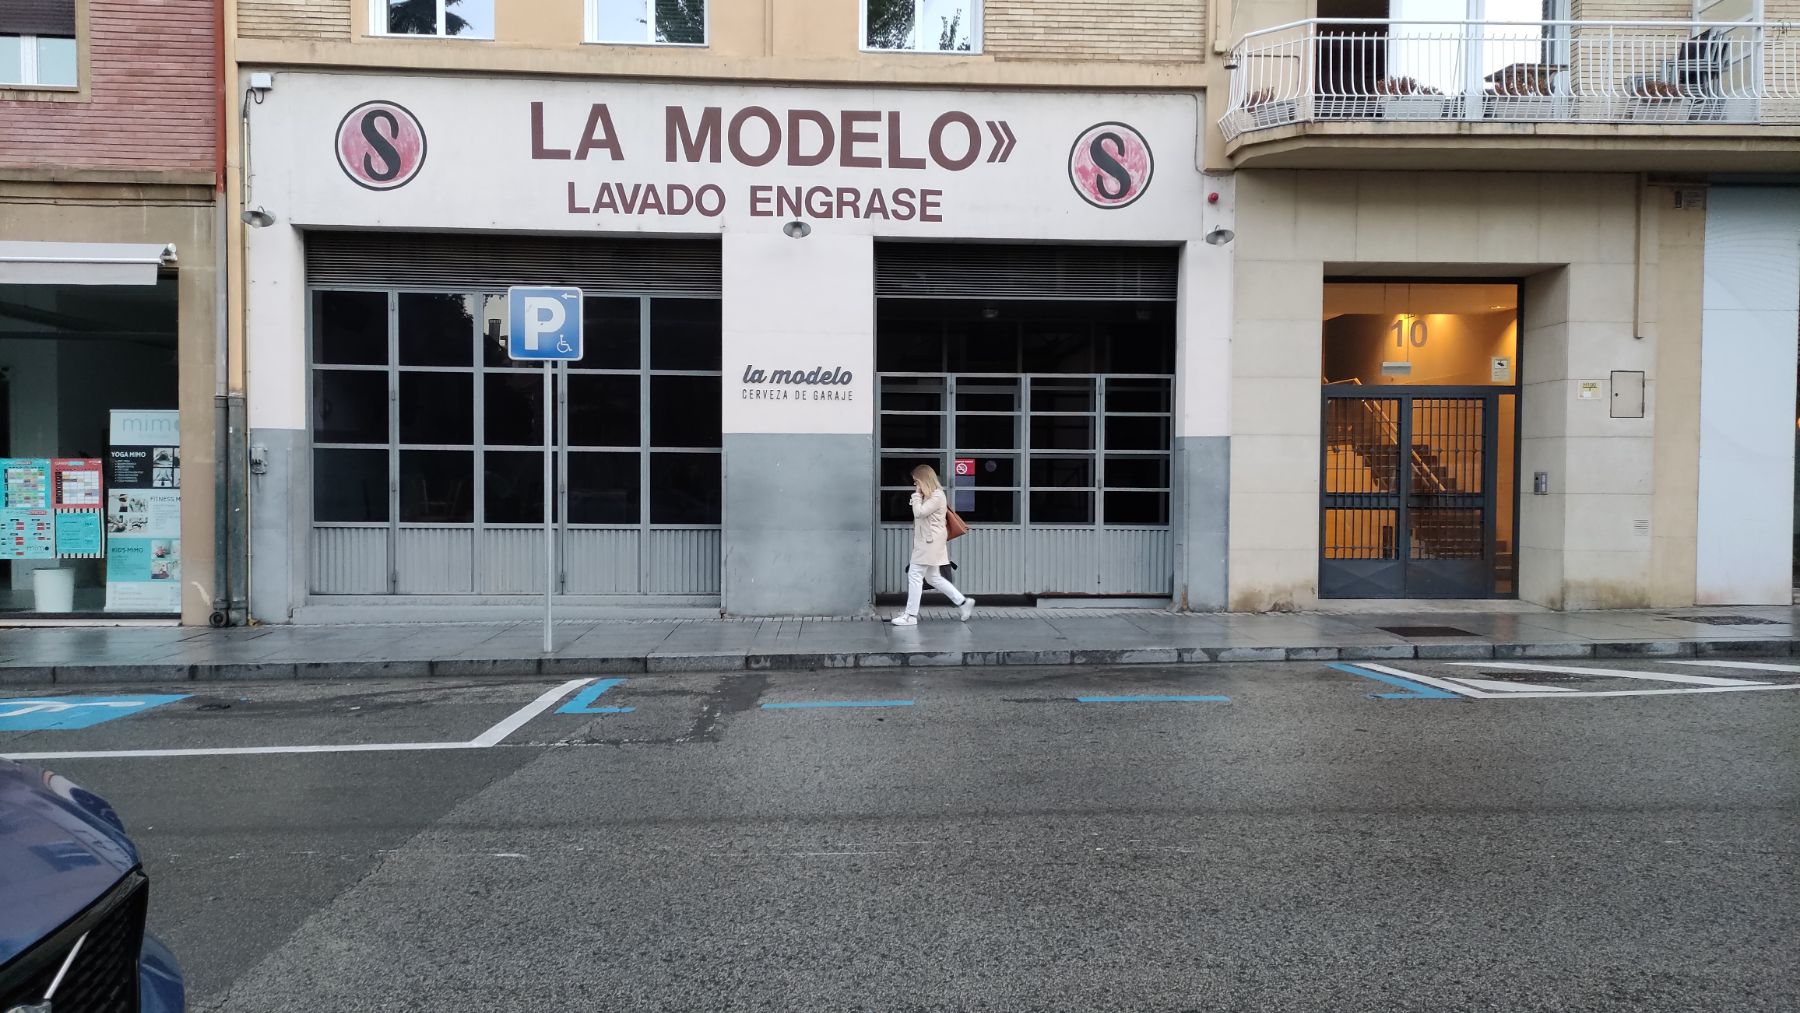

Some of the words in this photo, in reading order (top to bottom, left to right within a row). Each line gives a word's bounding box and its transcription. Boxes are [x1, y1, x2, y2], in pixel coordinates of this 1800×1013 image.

[530, 101, 625, 161] LA
[567, 181, 726, 217] LAVADO
[749, 185, 943, 223] ENGRASE
[524, 296, 566, 351] P
[1391, 319, 1428, 348] 10
[742, 364, 767, 384] la
[769, 366, 853, 385] modelo
[742, 388, 788, 400] CERVEZA
[794, 390, 807, 401] DE
[813, 390, 853, 401] GARAJE
